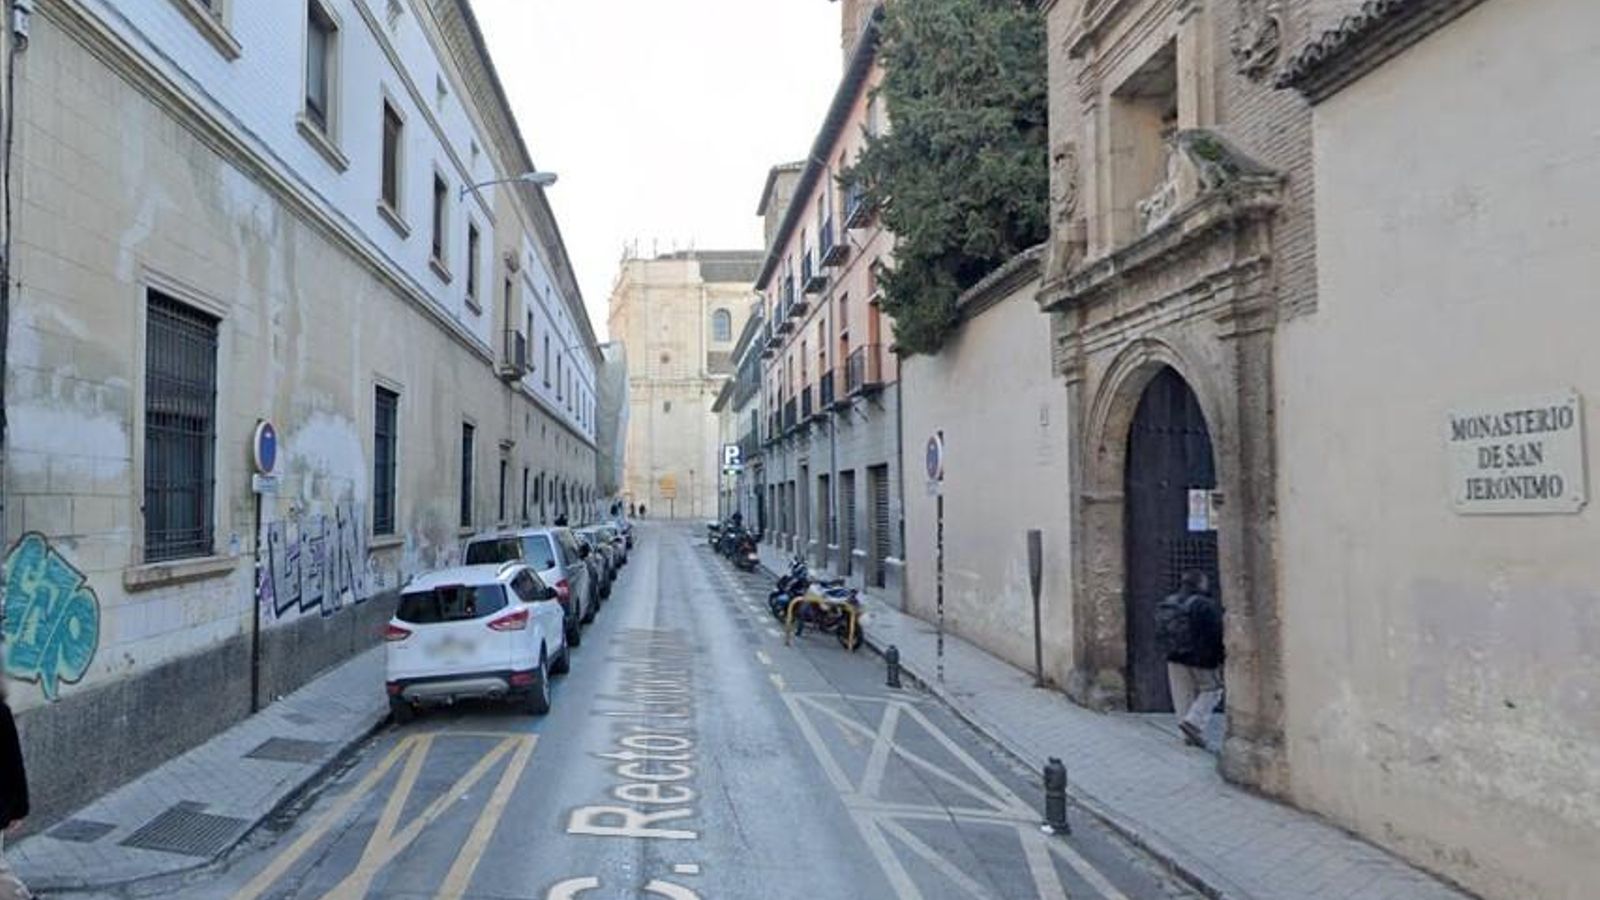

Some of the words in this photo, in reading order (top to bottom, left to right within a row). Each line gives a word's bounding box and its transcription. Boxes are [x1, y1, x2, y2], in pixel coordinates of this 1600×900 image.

[1451, 406, 1574, 441] MONASTERIO
[1478, 445, 1503, 469] DE
[1505, 442, 1543, 468] SAN
